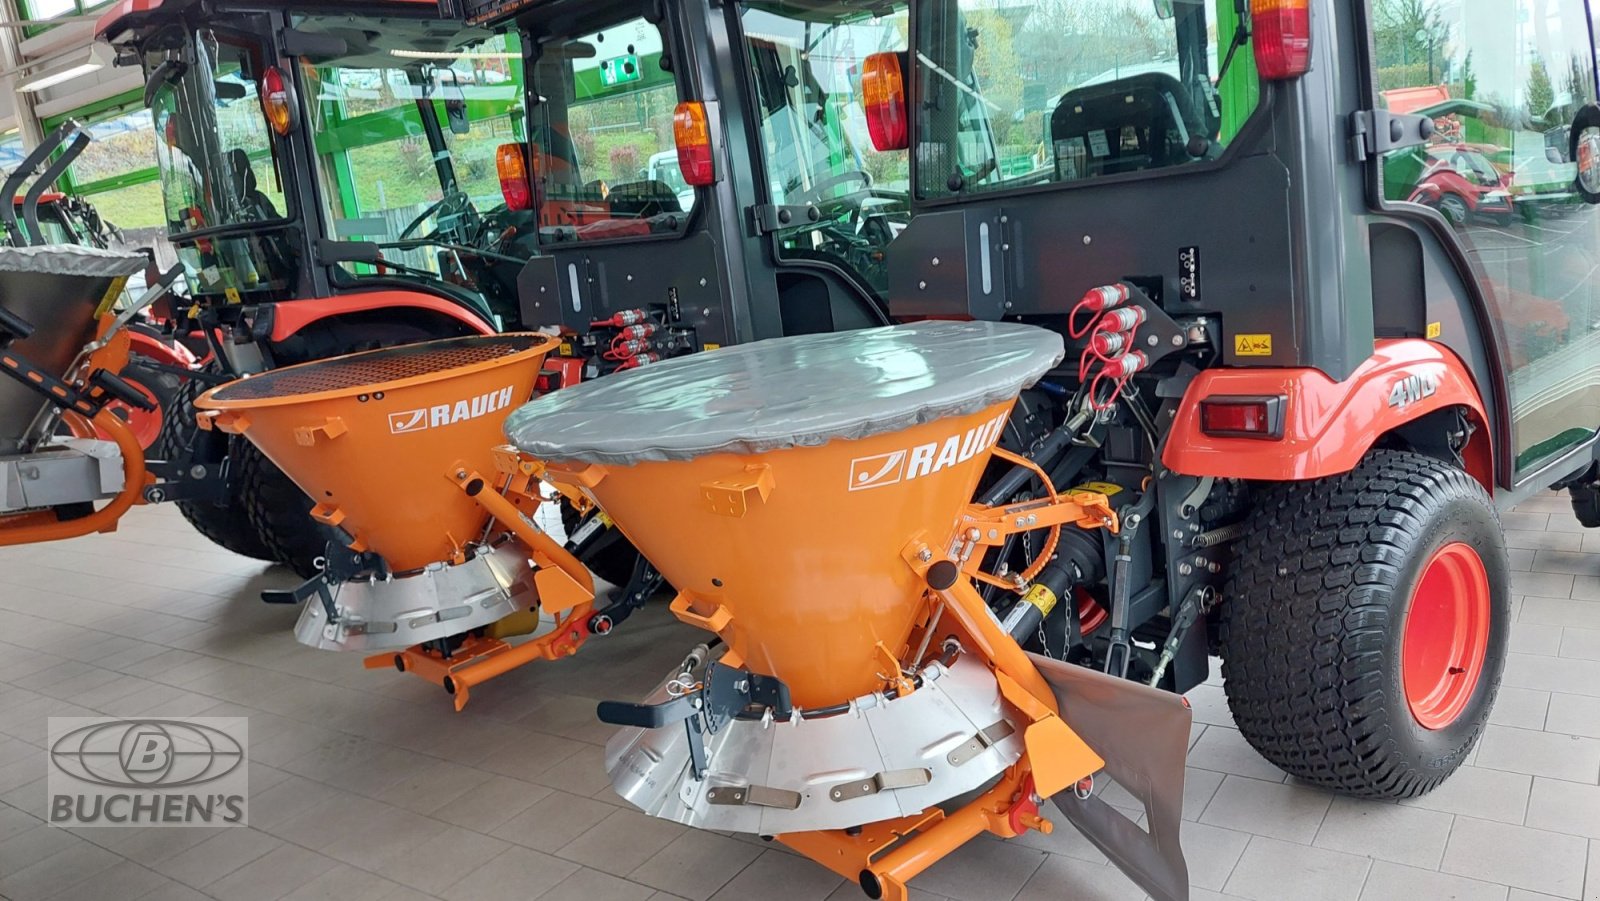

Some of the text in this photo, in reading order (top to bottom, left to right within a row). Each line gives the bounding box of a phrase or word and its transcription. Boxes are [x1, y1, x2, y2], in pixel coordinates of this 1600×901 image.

[431, 385, 514, 428] RAUCH
[1388, 372, 1437, 408] 4WD
[906, 409, 1010, 480] RAUCH
